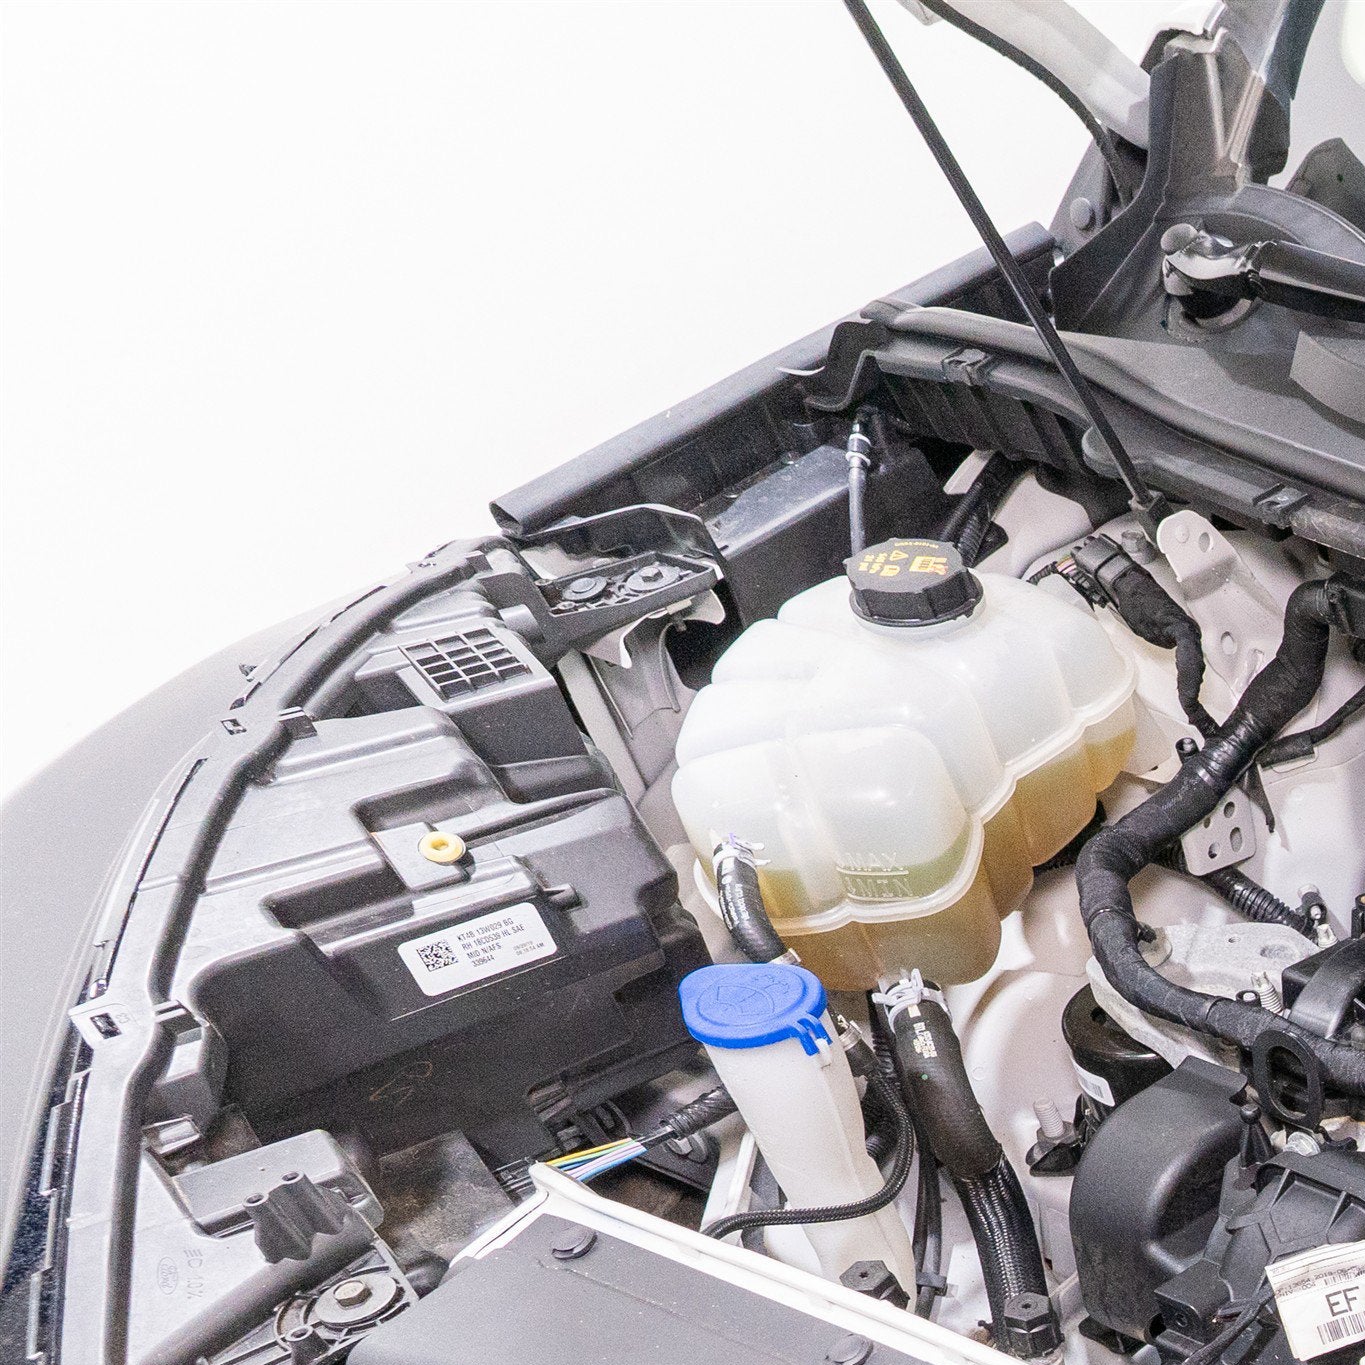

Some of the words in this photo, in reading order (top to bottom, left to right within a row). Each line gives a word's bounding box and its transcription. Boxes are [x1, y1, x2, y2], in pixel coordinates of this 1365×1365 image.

[846, 852, 904, 870] MAX
[856, 877, 913, 897] MIN
[462, 941, 473, 951] RH
[512, 924, 525, 935] SAE
[1325, 1286, 1359, 1317] EF
